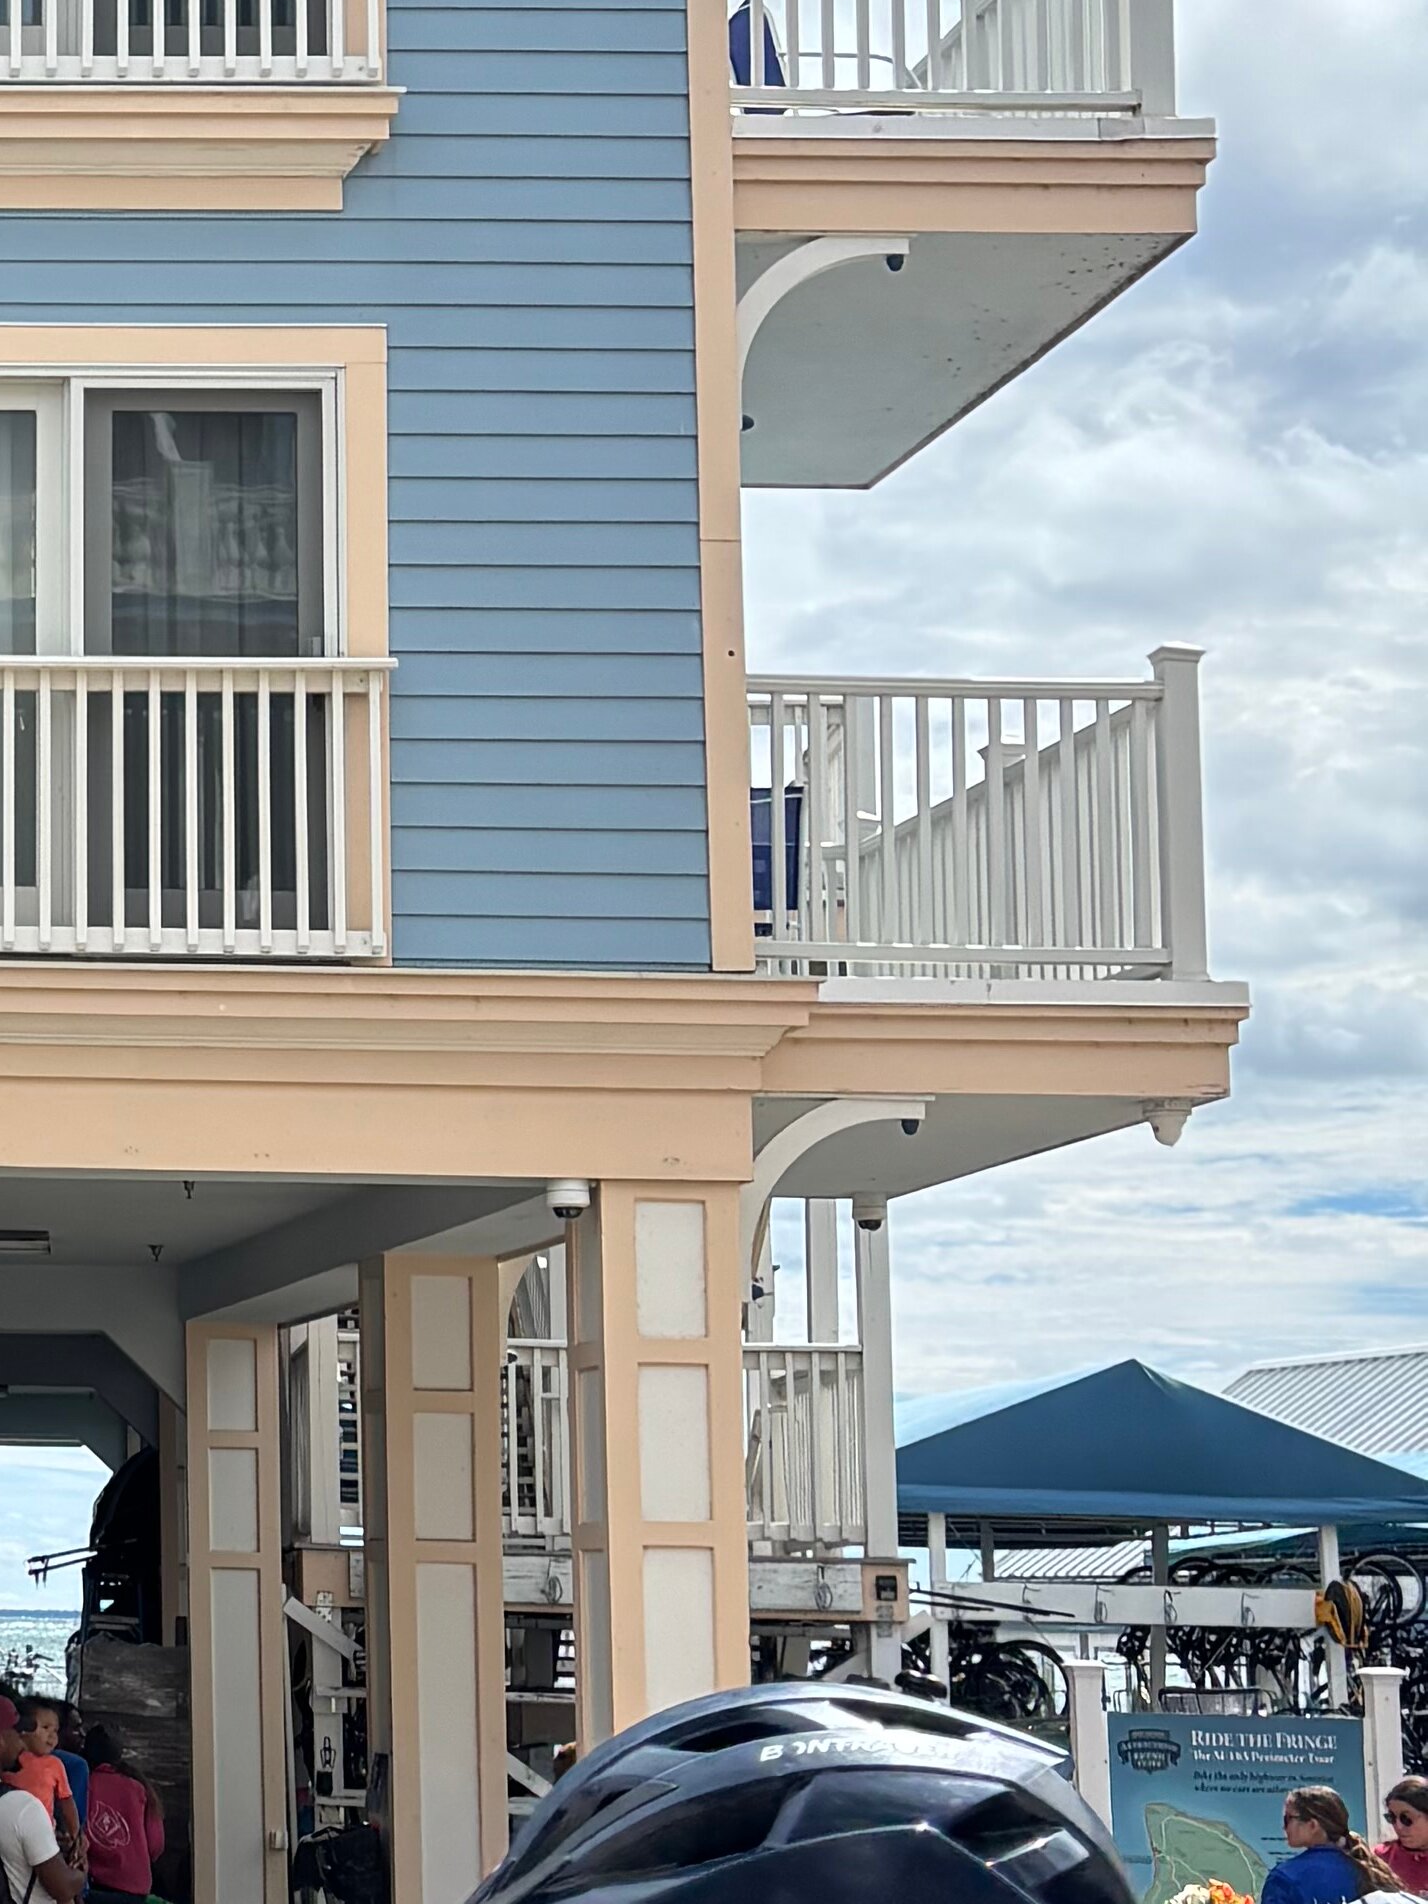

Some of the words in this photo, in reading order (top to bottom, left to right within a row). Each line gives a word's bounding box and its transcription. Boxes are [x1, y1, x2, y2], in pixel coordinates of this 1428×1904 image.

[1191, 1729, 1234, 1747] RIDE
[1236, 1732, 1273, 1748] THE
[1275, 1731, 1338, 1750] FRINGE
